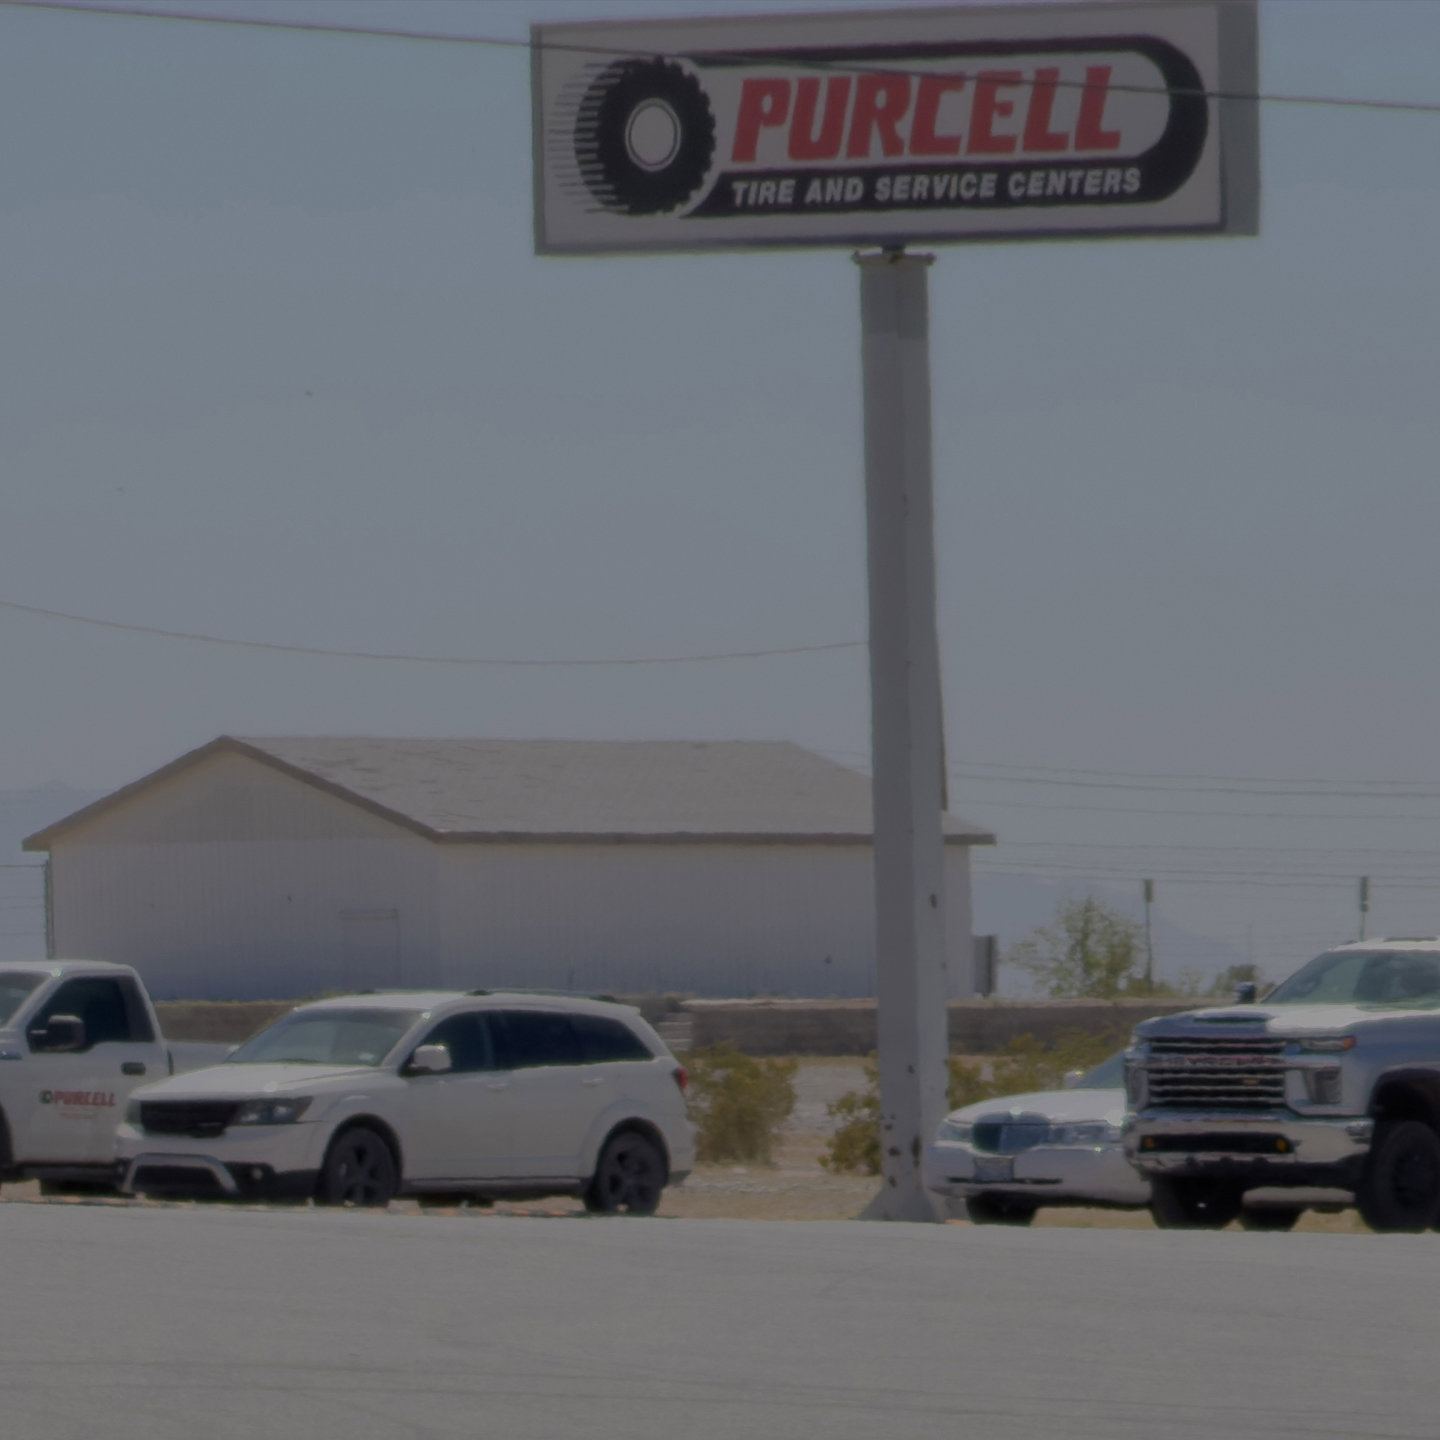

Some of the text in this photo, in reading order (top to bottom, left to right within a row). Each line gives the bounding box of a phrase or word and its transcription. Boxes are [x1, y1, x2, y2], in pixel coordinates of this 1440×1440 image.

[731, 65, 1121, 163] PURCELL
[731, 167, 1142, 207] TIRE AND SERVICE CENTERS
